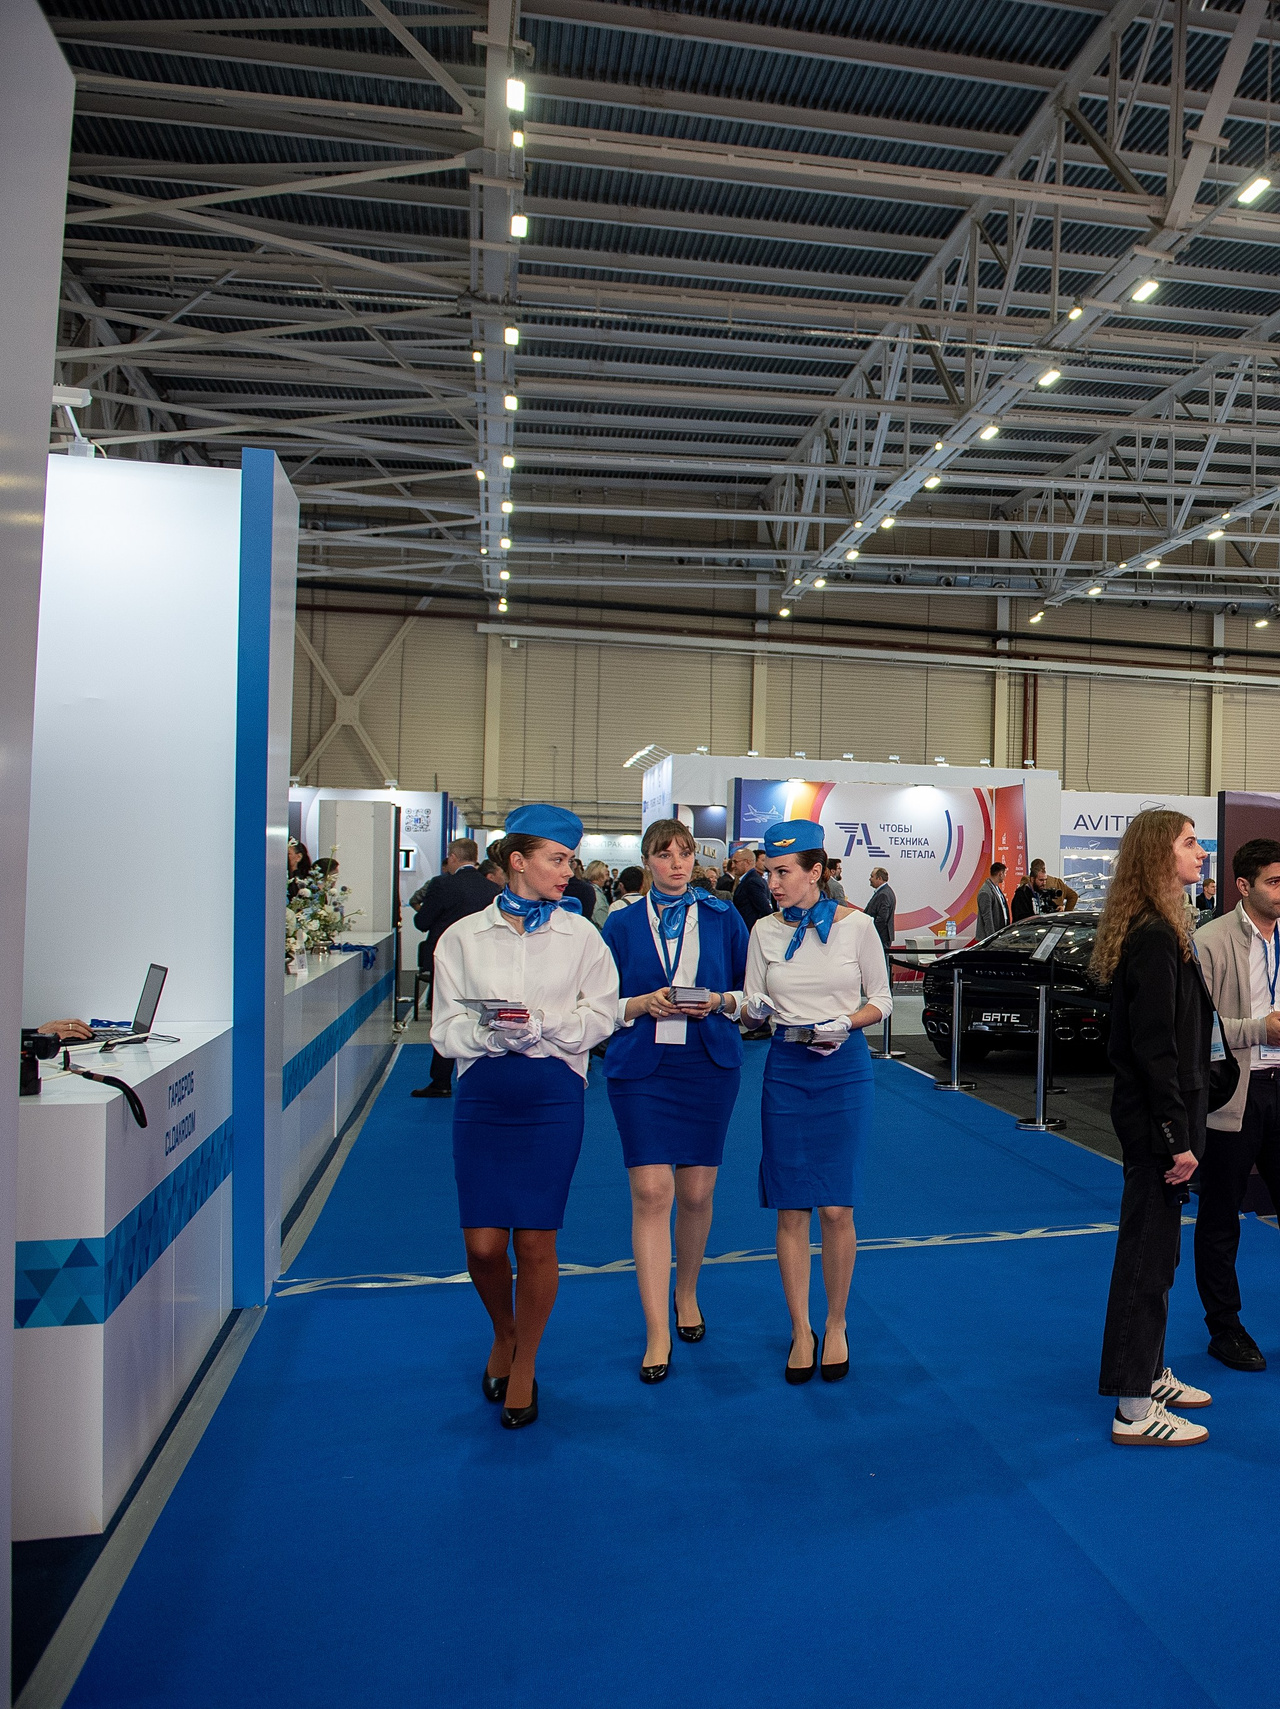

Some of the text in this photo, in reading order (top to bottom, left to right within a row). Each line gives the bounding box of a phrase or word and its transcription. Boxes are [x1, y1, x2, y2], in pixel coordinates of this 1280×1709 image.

[879, 823, 913, 834] ЧТОБЫ
[888, 836, 930, 847] ТЕХНИКА
[899, 849, 937, 860] ЛЕТАЛА
[982, 1012, 1021, 1023] GATE
[168, 1070, 194, 1110] ГАРДЕРОБ
[165, 1110, 196, 1156] CLOAKROOM
